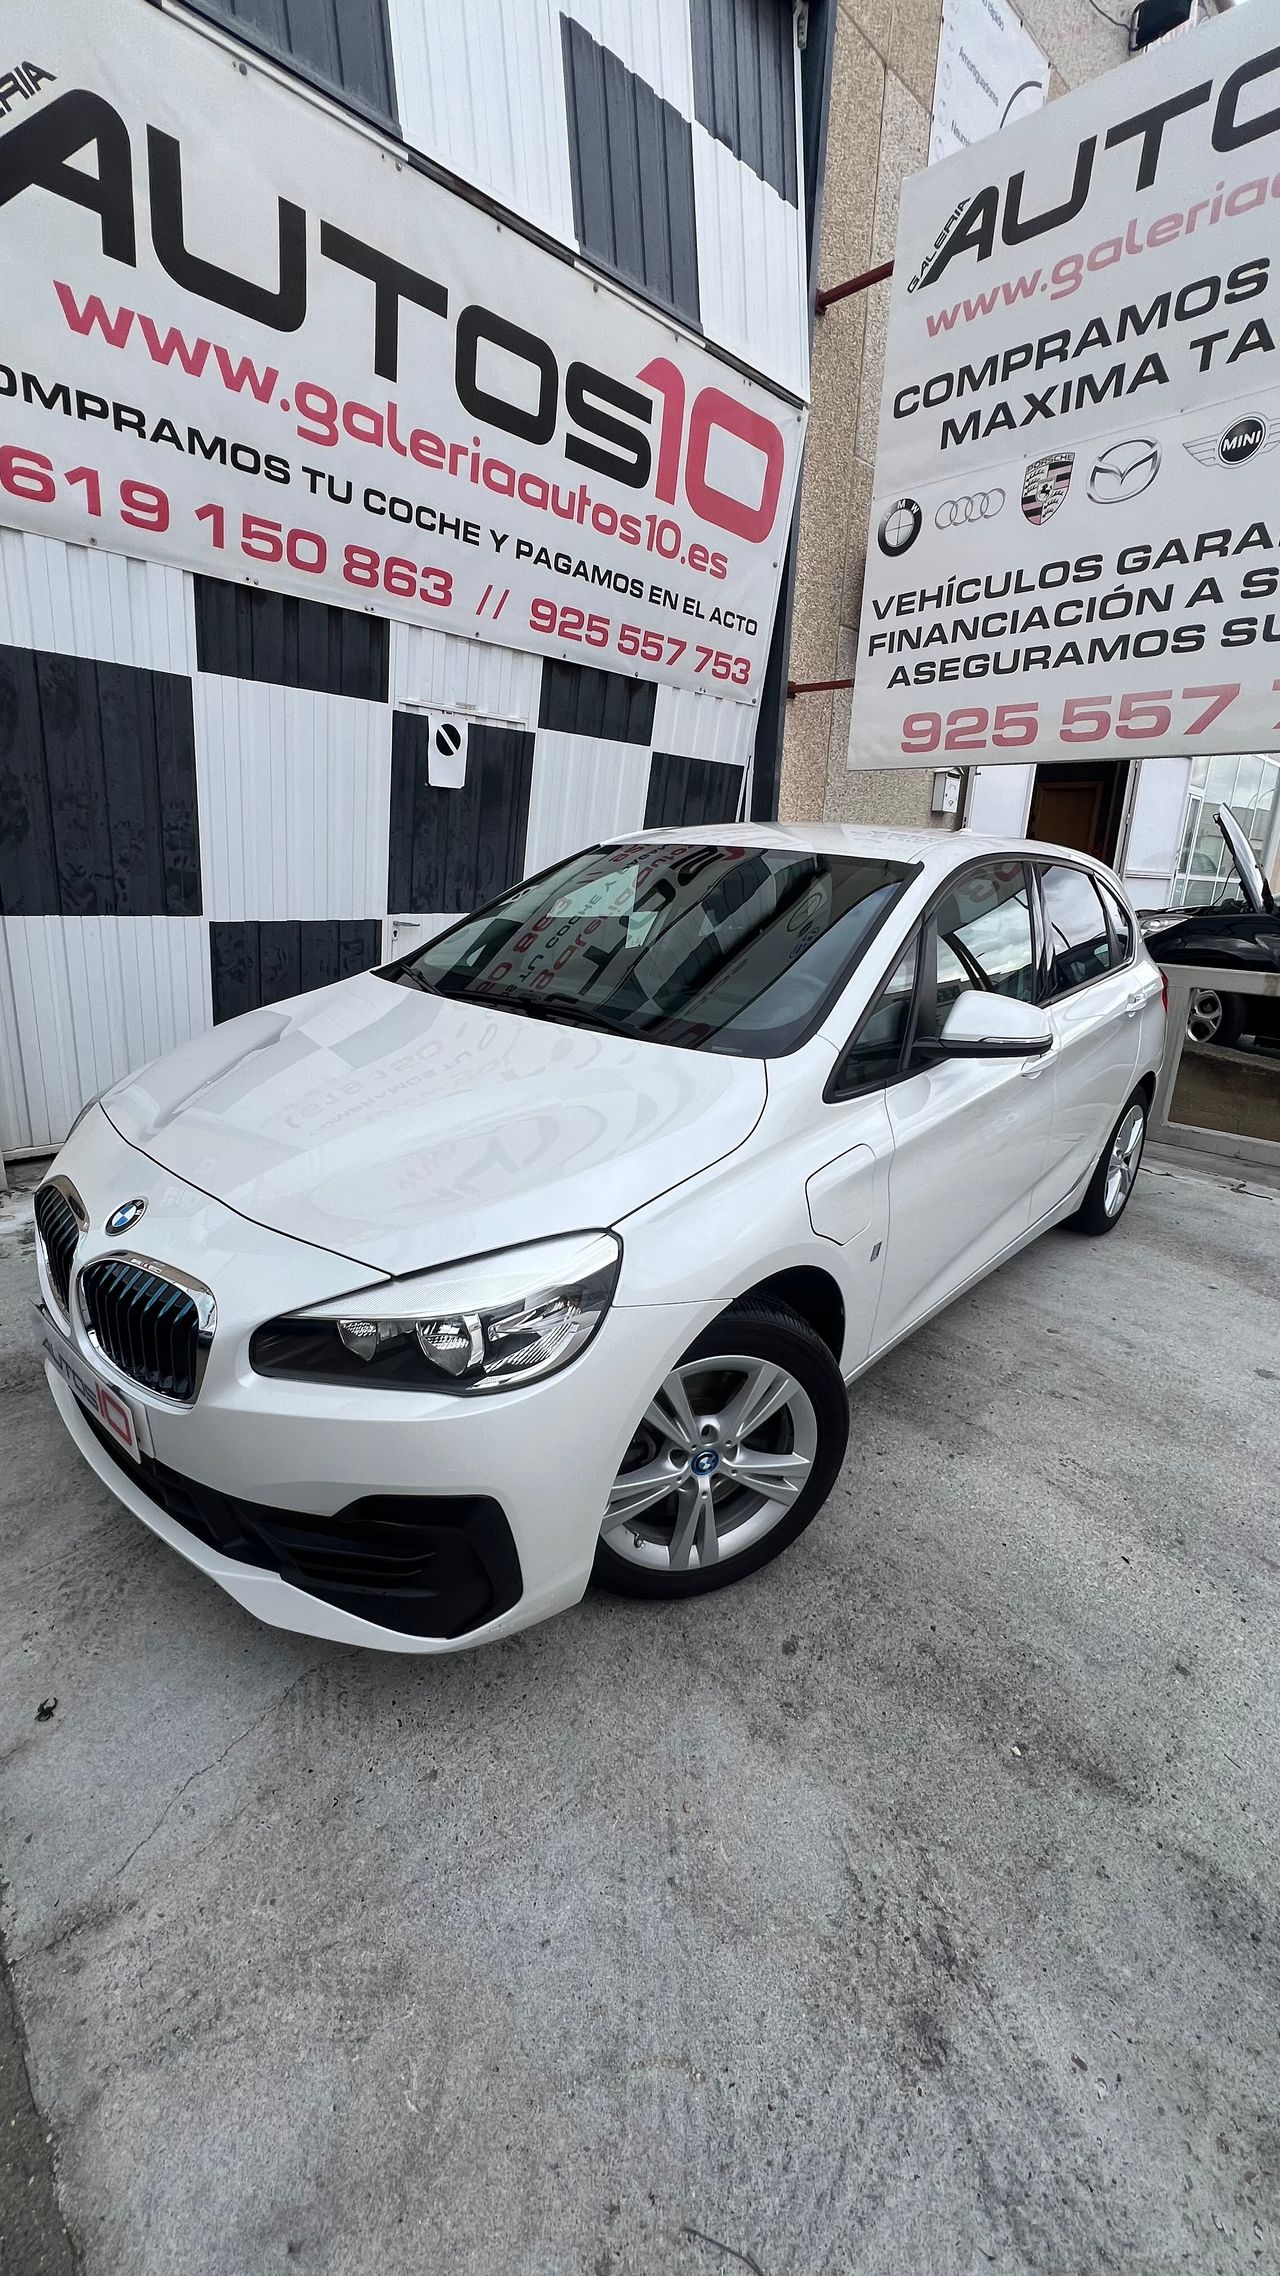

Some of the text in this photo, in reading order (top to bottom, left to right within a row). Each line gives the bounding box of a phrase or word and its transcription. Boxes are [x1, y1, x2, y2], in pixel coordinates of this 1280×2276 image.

[0, 60, 57, 118] RIA
[907, 197, 971, 293] GALERIA
[926, 172, 1280, 337] www.galeria
[0, 88, 785, 544] AUTOS10
[893, 257, 1271, 419] COMPRAMOS
[53, 280, 728, 580] www.galeriaautos10.es
[940, 318, 1276, 450] MAXIMA TA
[1223, 430, 1261, 452] MINI
[0, 445, 170, 533] 619
[194, 503, 327, 574] 150
[343, 544, 453, 607] 863
[529, 598, 611, 648] 925
[617, 622, 687, 666] 557
[693, 645, 752, 684] 753
[302, 466, 353, 504] TU
[363, 487, 481, 547] COCHE
[489, 529, 509, 554] Y
[516, 538, 643, 600] PAGAMOS
[648, 586, 680, 611] EN
[682, 597, 705, 619] EL
[709, 607, 758, 636] ACTO
[872, 521, 1280, 621] VEHÍCULOS GARA
[868, 583, 1174, 657] FINANCIACIÓN
[1184, 577, 1223, 608] A
[886, 625, 1206, 689] ASEGURAMOS
[900, 702, 1039, 754] 925
[1058, 683, 1241, 744] 557
